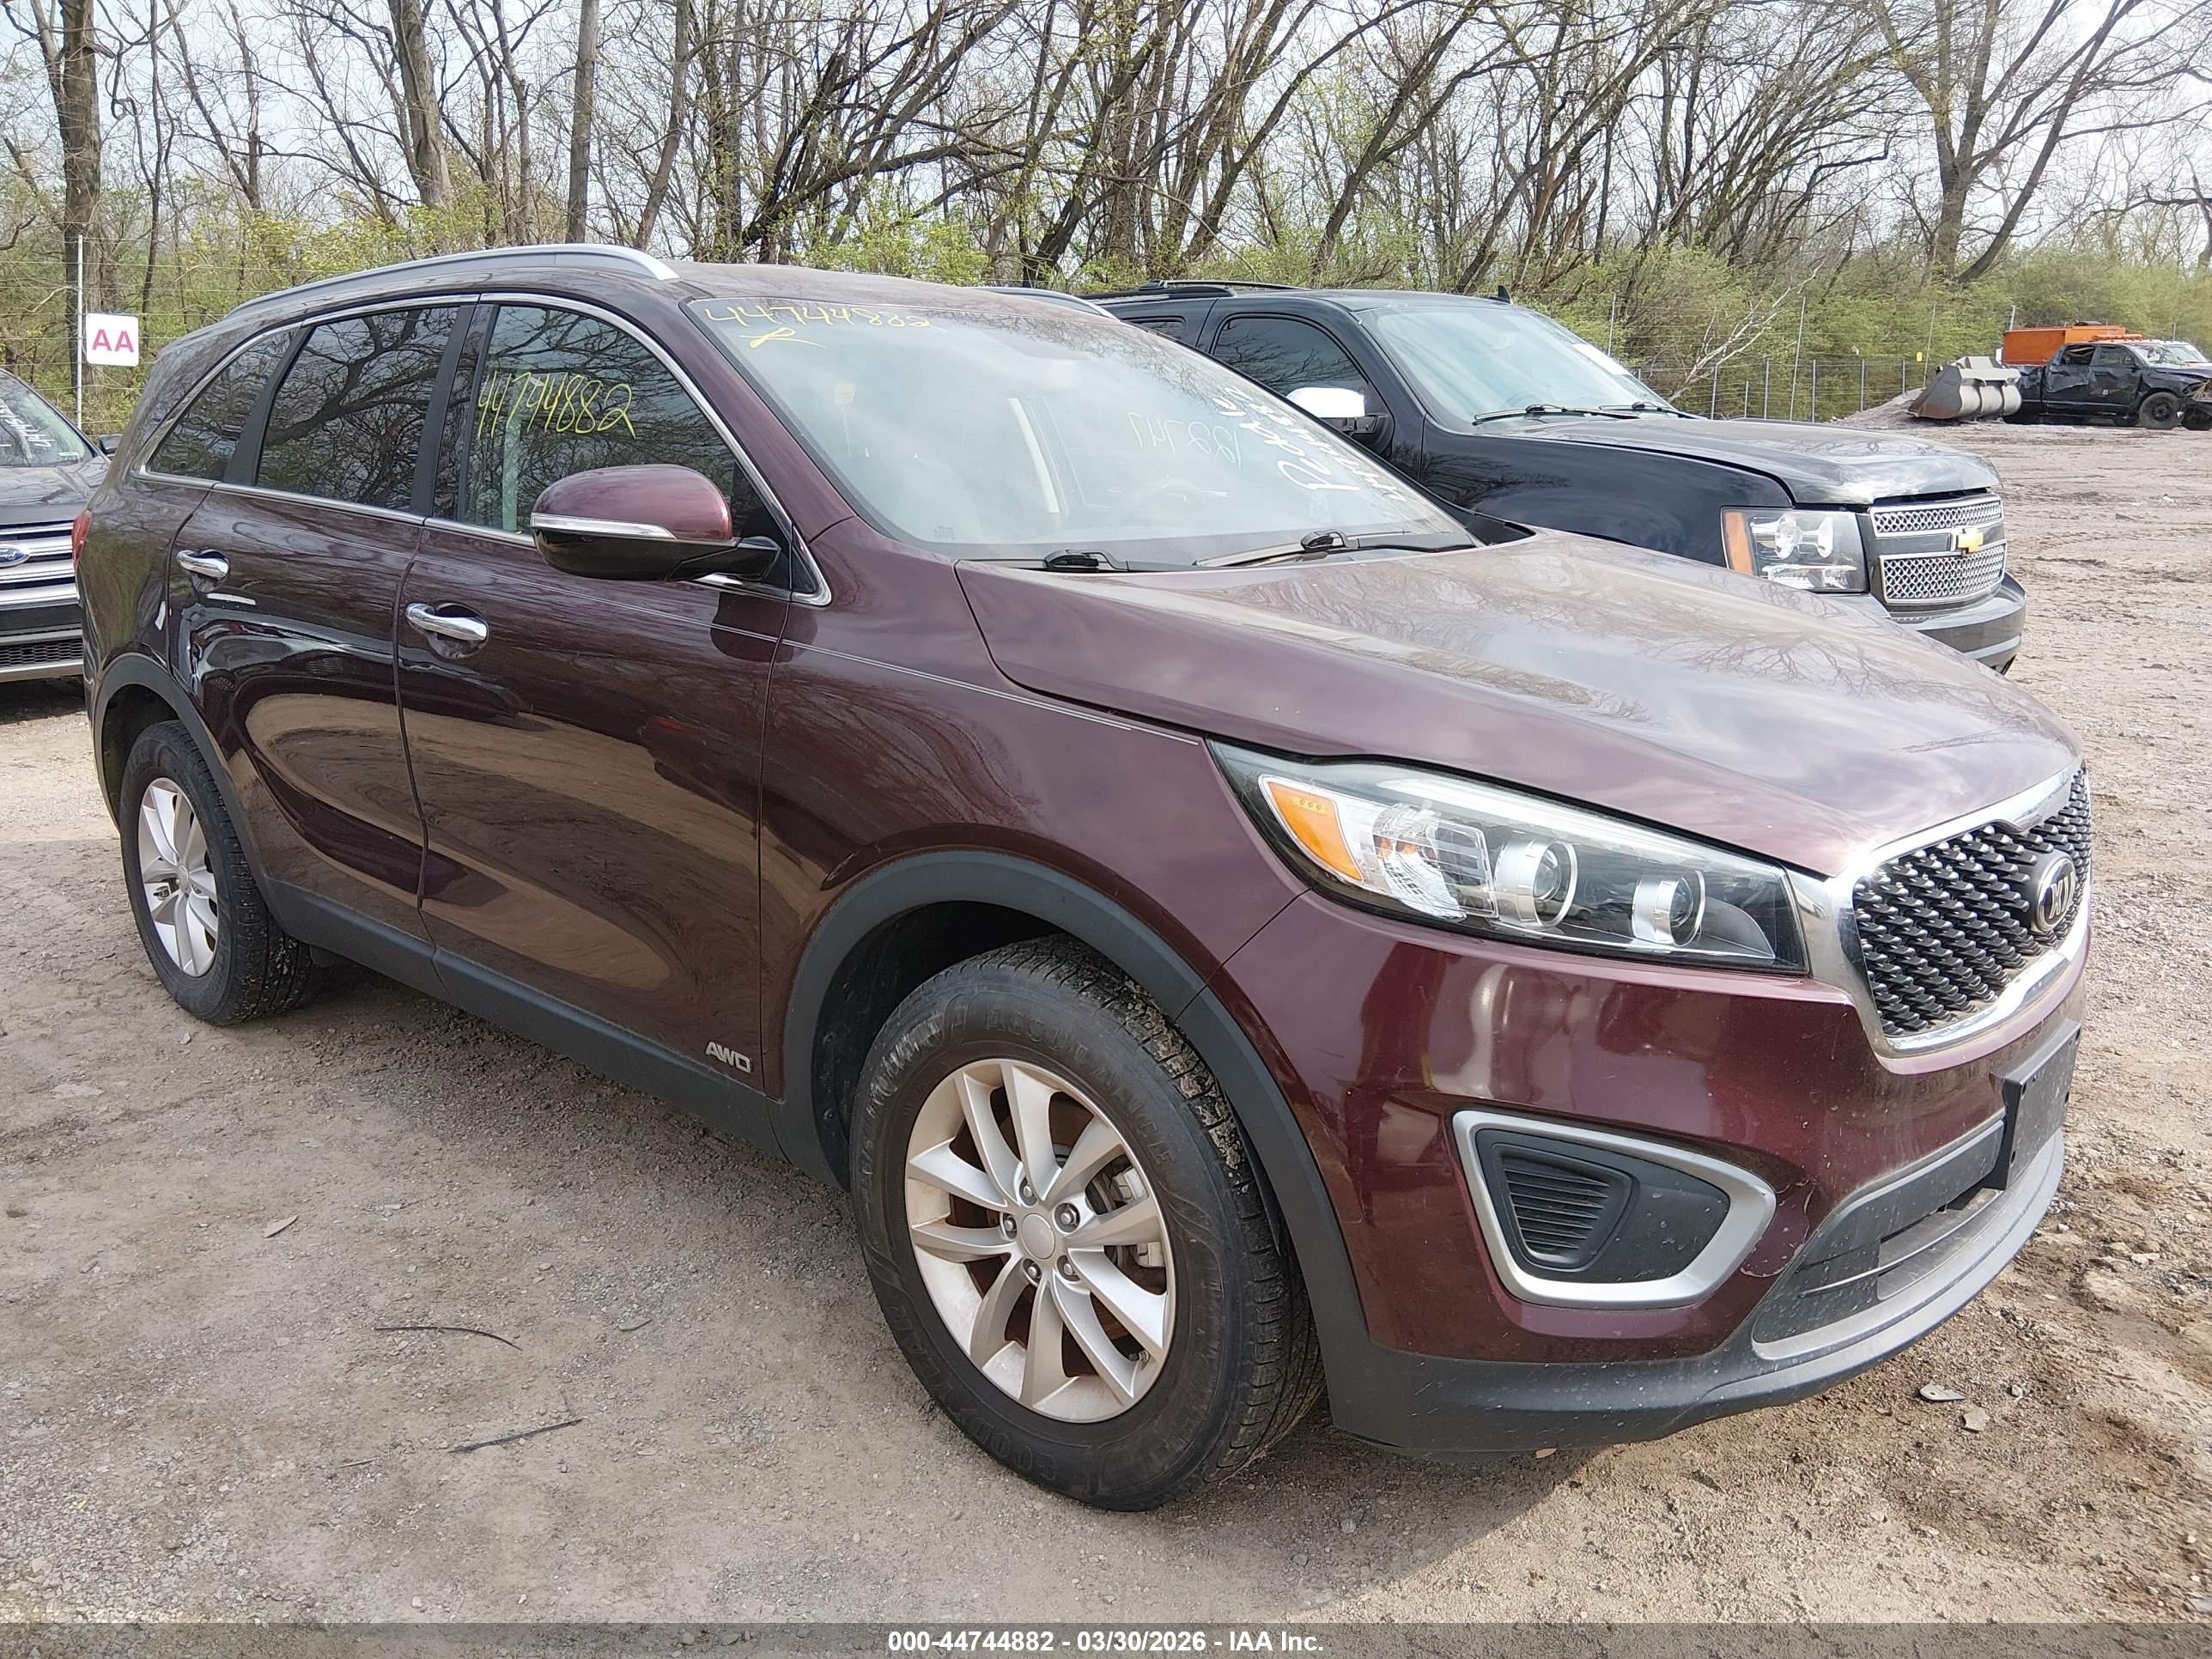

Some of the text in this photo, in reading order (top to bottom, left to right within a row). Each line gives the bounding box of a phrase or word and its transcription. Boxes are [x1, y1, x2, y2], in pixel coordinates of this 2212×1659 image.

[704, 306, 934, 328] 44744882
[92, 329, 134, 353] AA
[477, 370, 636, 441] 44744882
[705, 1041, 750, 1073] AWD
